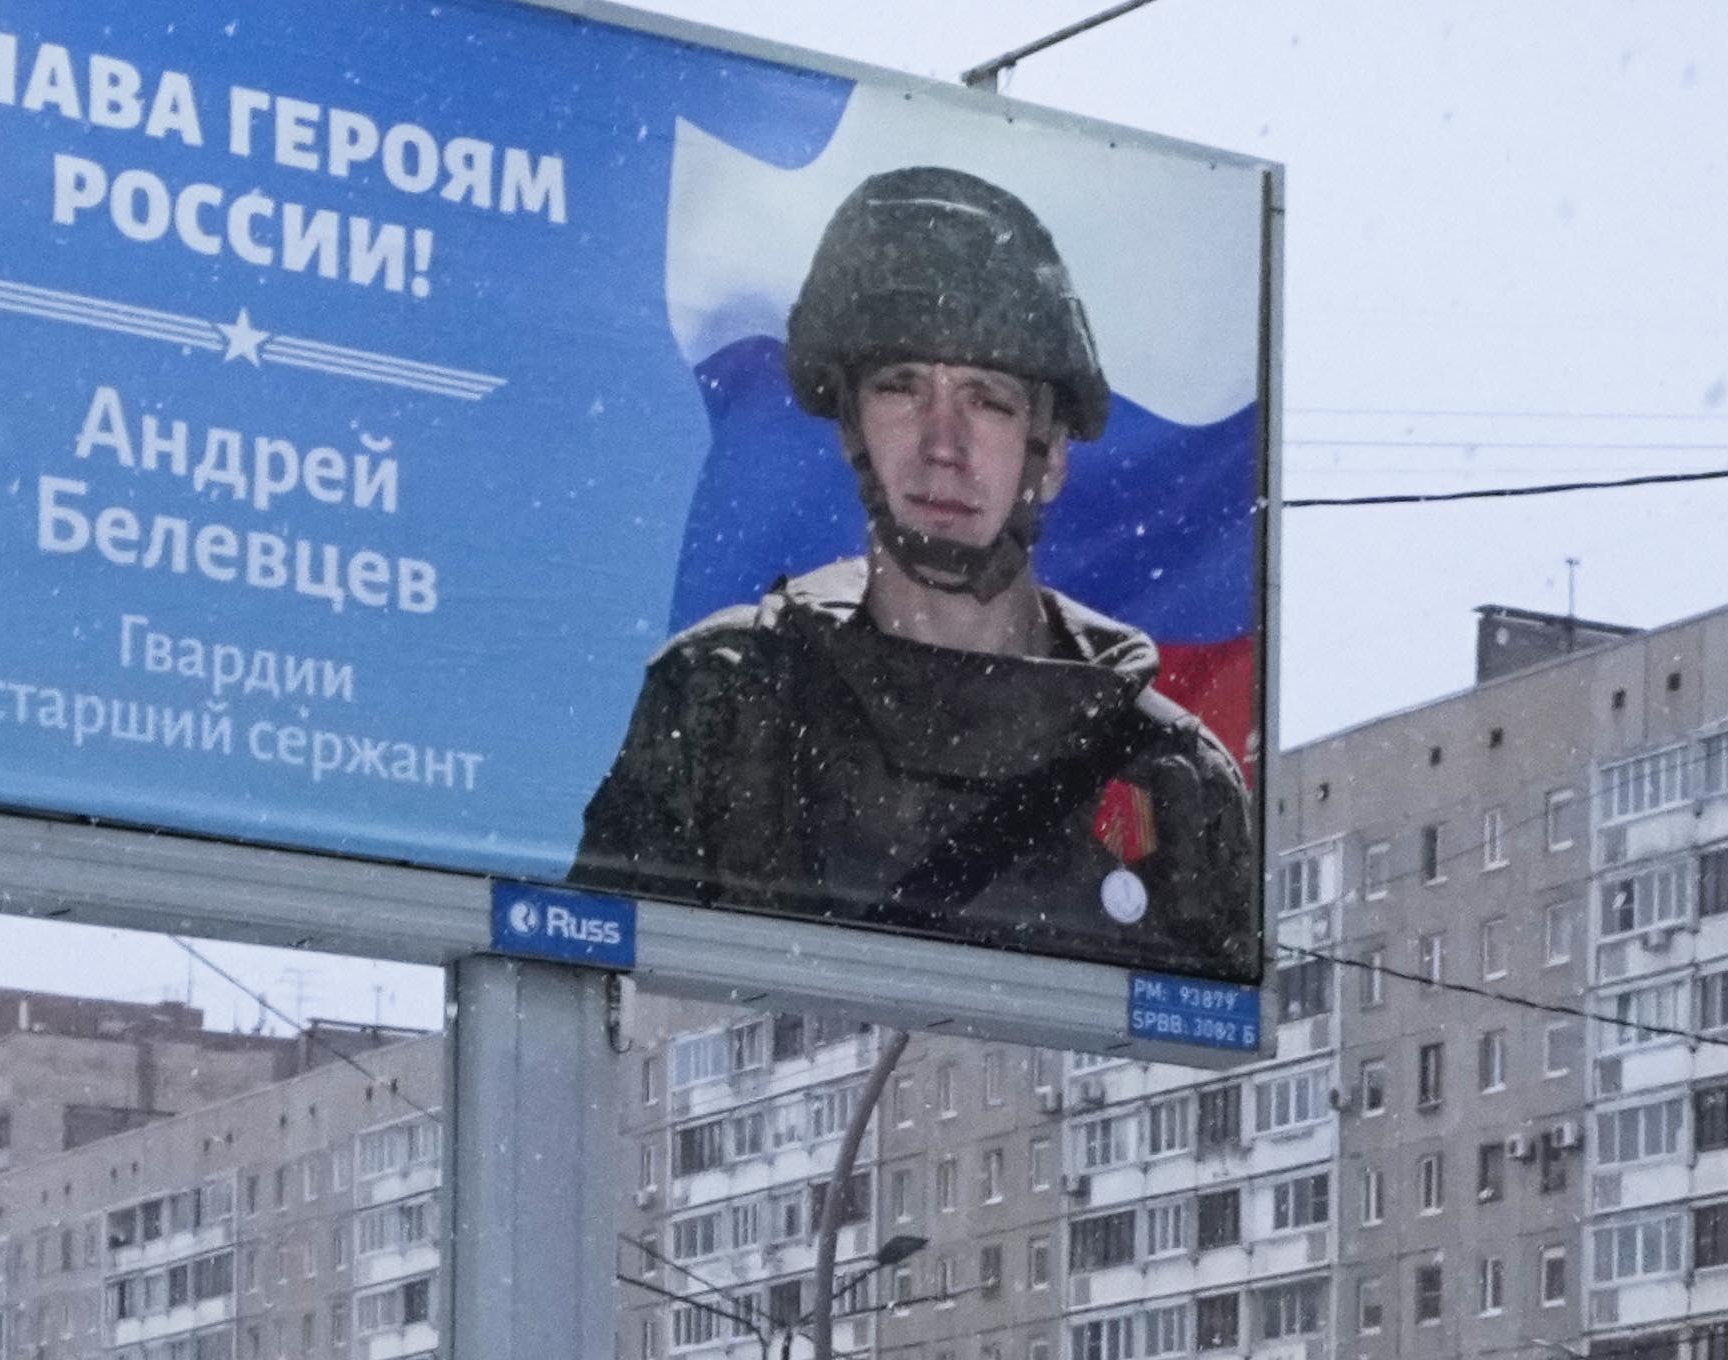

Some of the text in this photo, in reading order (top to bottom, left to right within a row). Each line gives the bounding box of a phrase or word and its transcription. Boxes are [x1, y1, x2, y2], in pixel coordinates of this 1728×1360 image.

[229, 86, 566, 224] ГЕРОЯМ
[53, 153, 434, 298] РОССИИ!
[76, 385, 398, 513] Андрей
[38, 474, 437, 613] Белевцев
[120, 613, 355, 703] Гвардии
[249, 718, 483, 790] сержант
[546, 905, 620, 944] Russ
